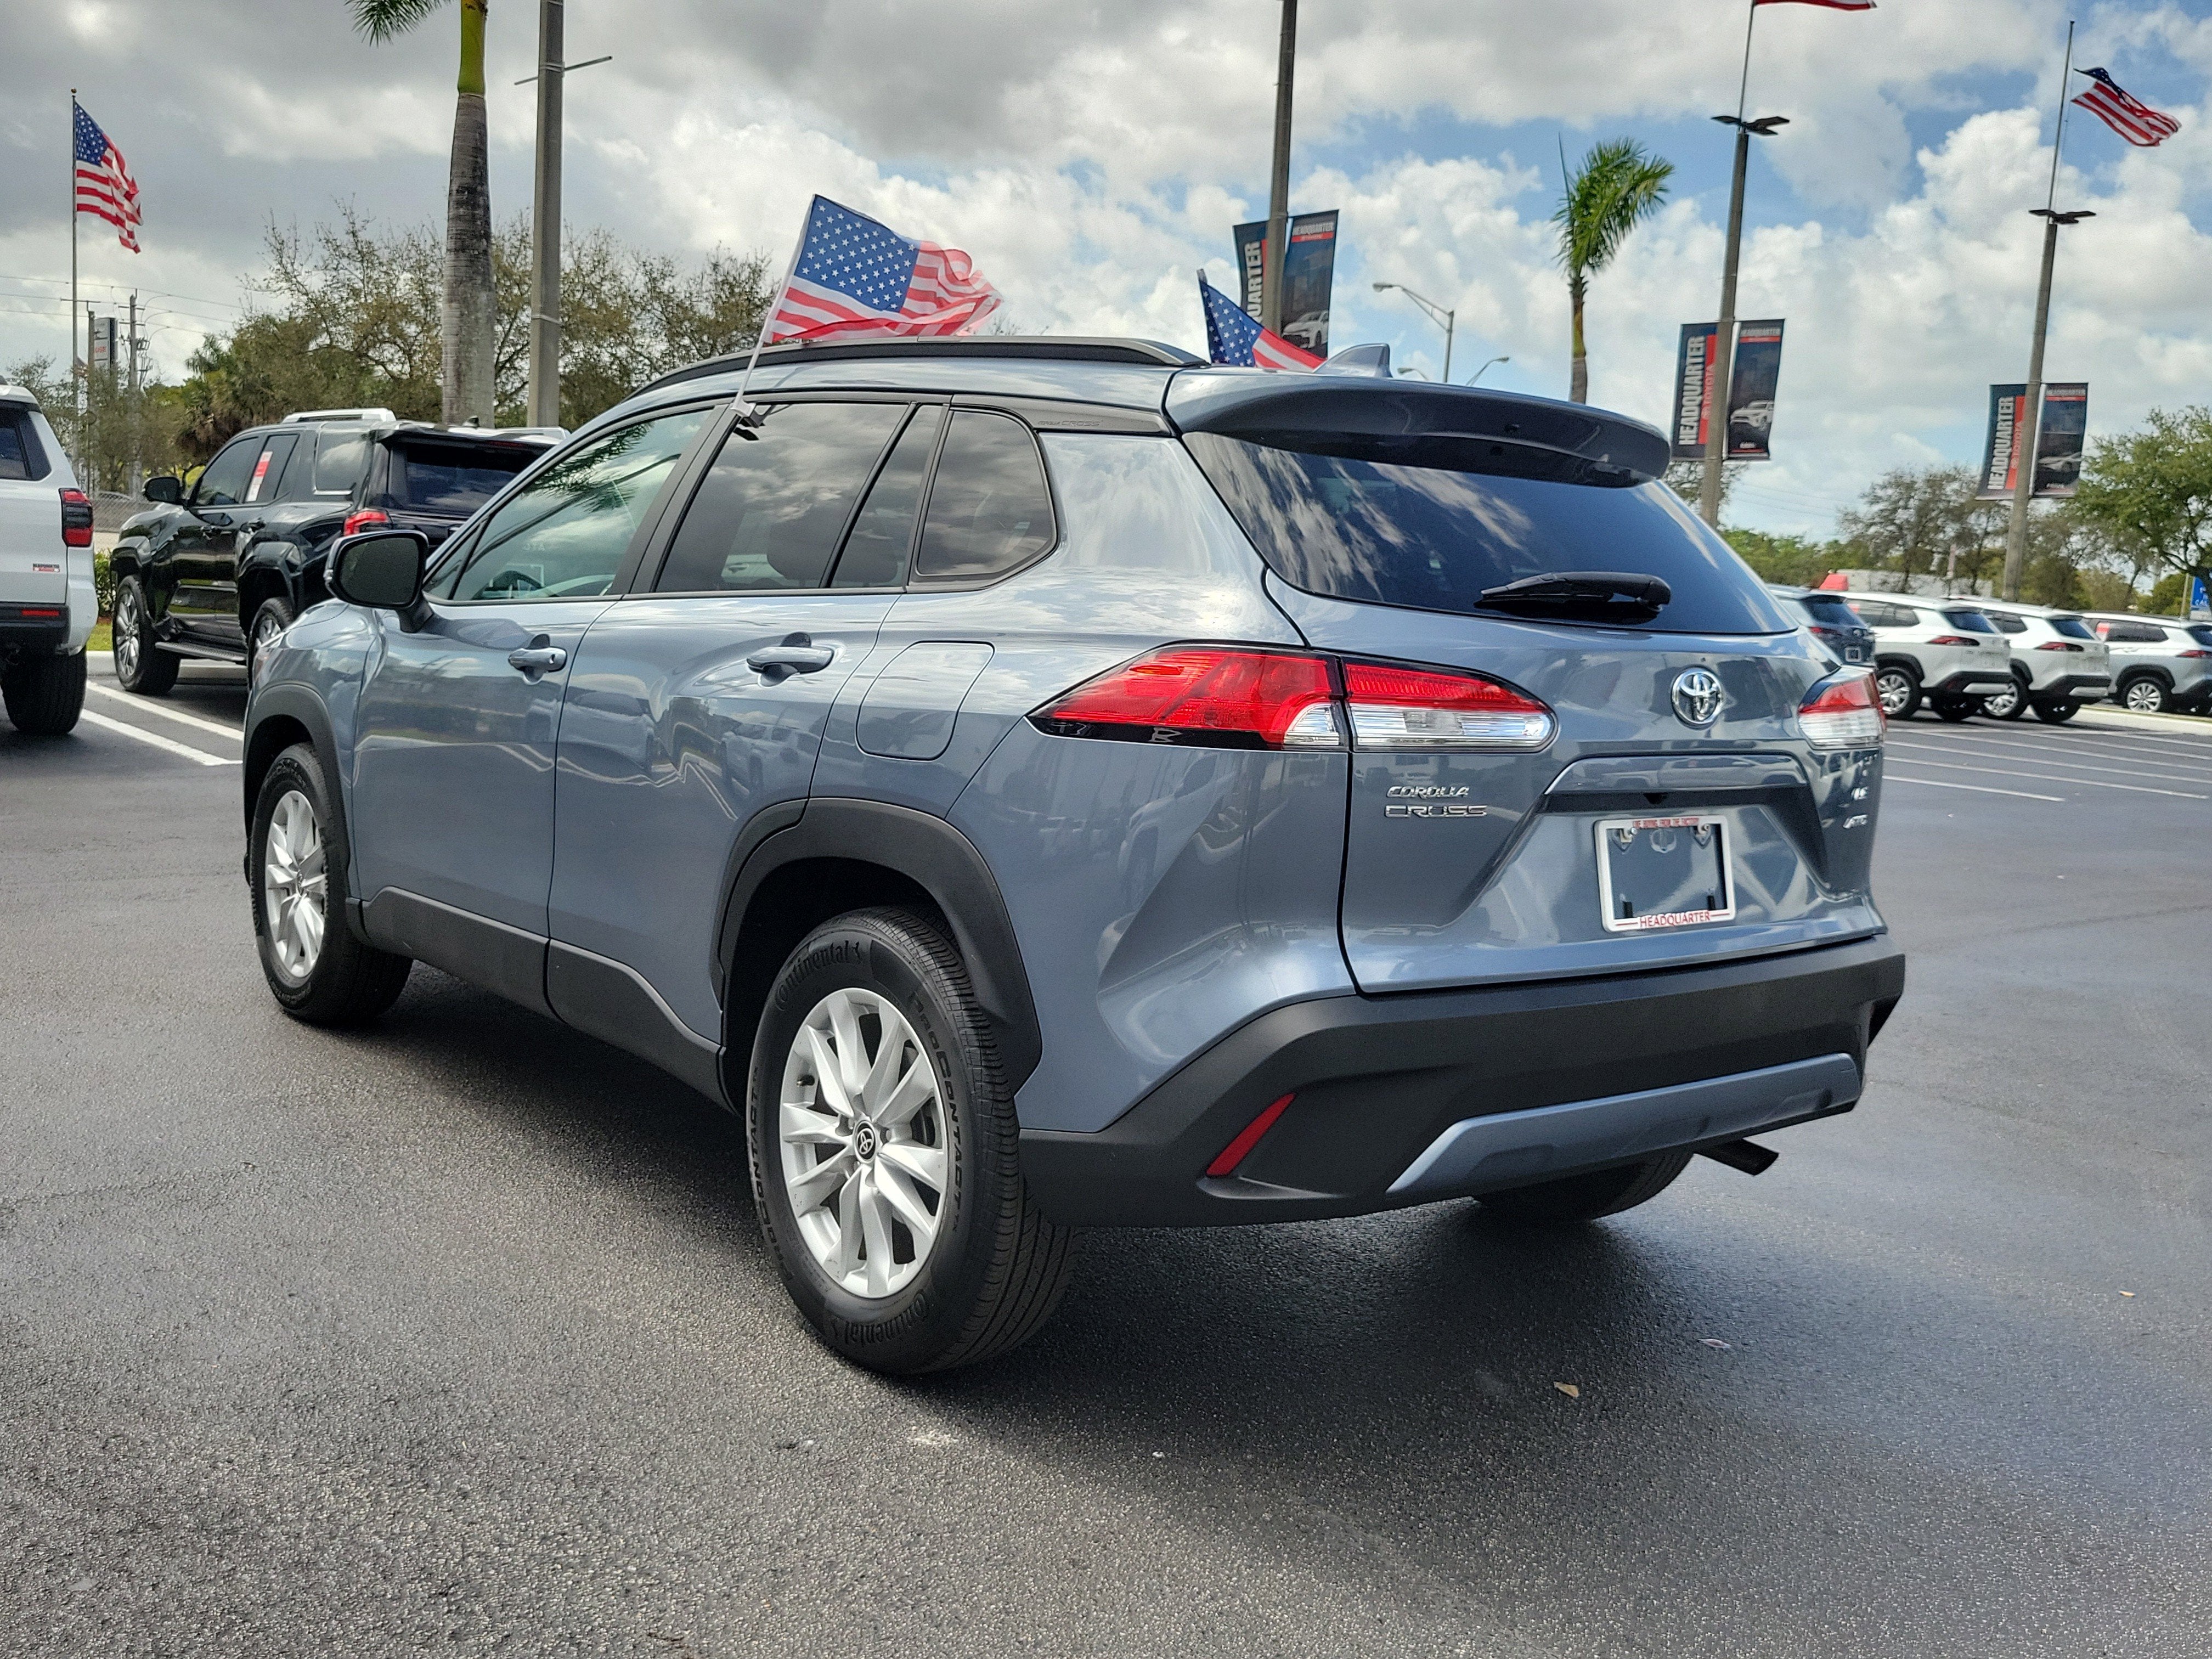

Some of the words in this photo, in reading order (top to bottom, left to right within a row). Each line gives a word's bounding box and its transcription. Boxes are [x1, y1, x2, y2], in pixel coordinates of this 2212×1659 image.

[1678, 335, 1706, 445] HEADQUARTER
[1987, 396, 2015, 490] HEADQUARTER
[1384, 804, 1488, 818] CROSS
[1386, 786, 1470, 799] COROLLA
[1639, 911, 1711, 927] HEADQUARTER
[775, 940, 849, 1011] Continental
